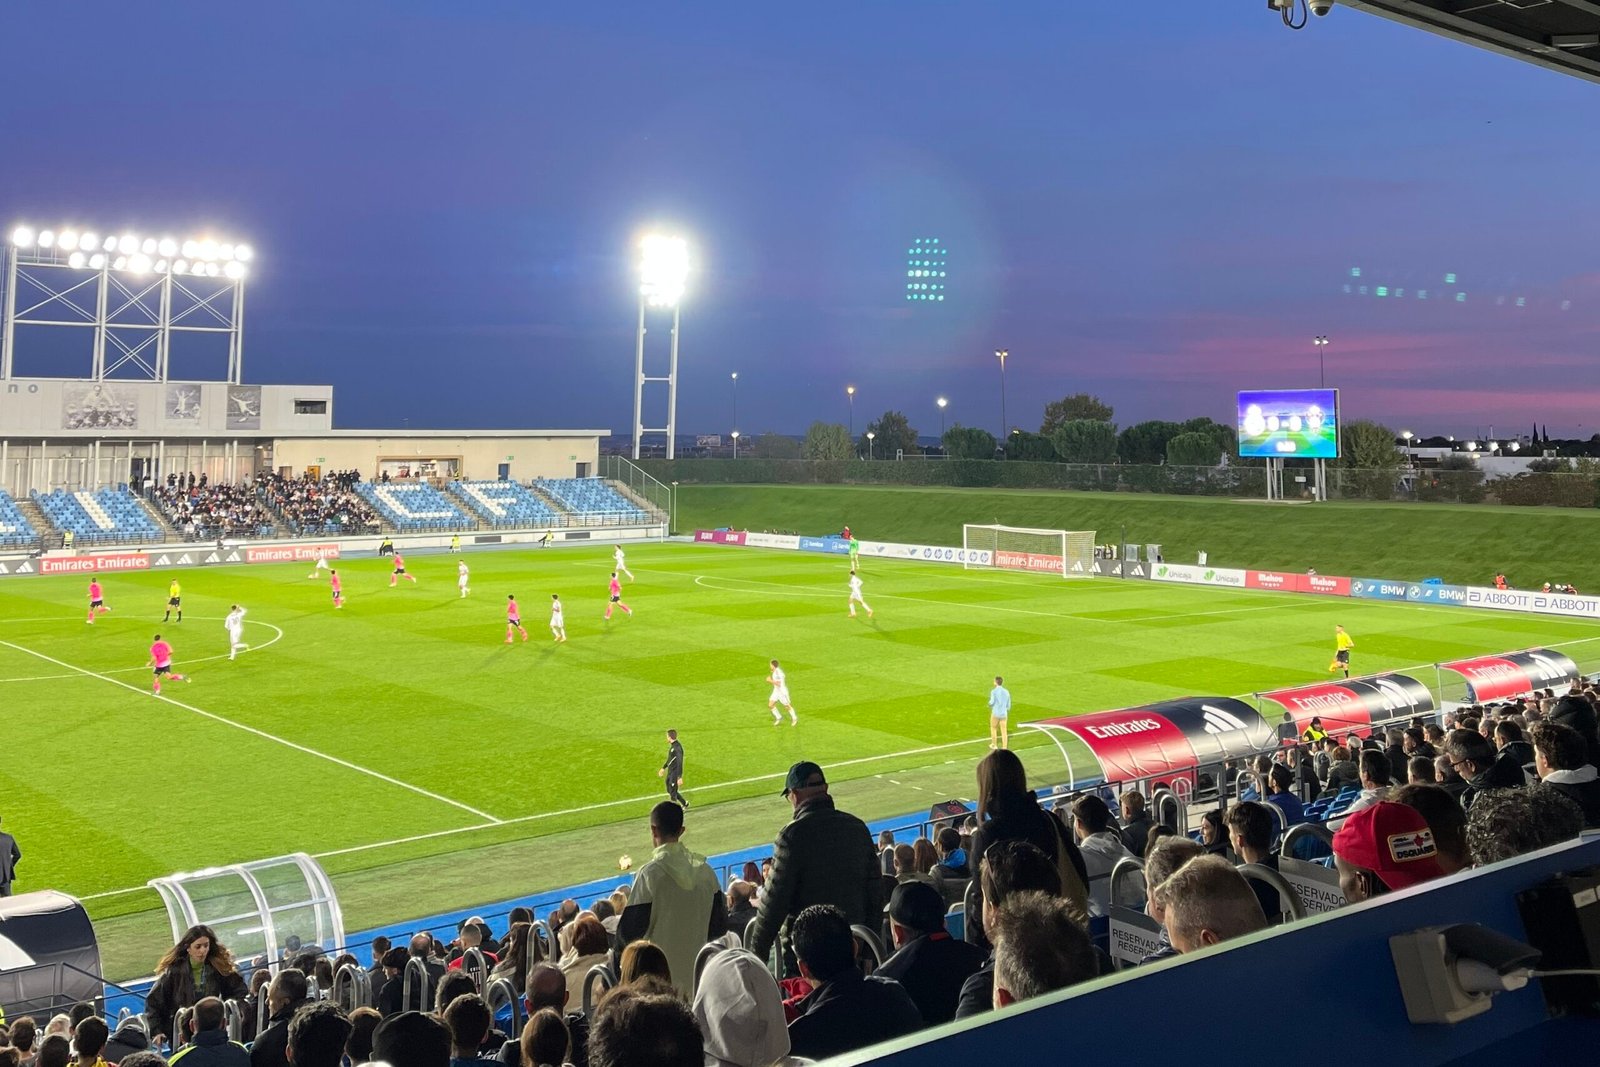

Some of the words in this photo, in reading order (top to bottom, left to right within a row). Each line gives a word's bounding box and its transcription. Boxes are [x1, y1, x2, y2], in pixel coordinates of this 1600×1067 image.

[248, 550, 293, 561] Emirates
[996, 554, 1027, 567] mirates
[42, 560, 94, 572] Emirates
[97, 556, 148, 569] Emirates
[1168, 571, 1193, 581] Unicaja
[1215, 575, 1240, 584] Unicaja
[1258, 573, 1283, 583] Mahou
[1310, 577, 1337, 588] Mahou
[1380, 585, 1405, 596] BMW
[1439, 590, 1464, 600] BMW
[1484, 593, 1529, 606] ABBOTT
[1550, 599, 1598, 612] ABBOTT
[1466, 663, 1515, 680] Emirates
[1293, 690, 1350, 712] Emirates
[1085, 718, 1161, 739] Emirates
